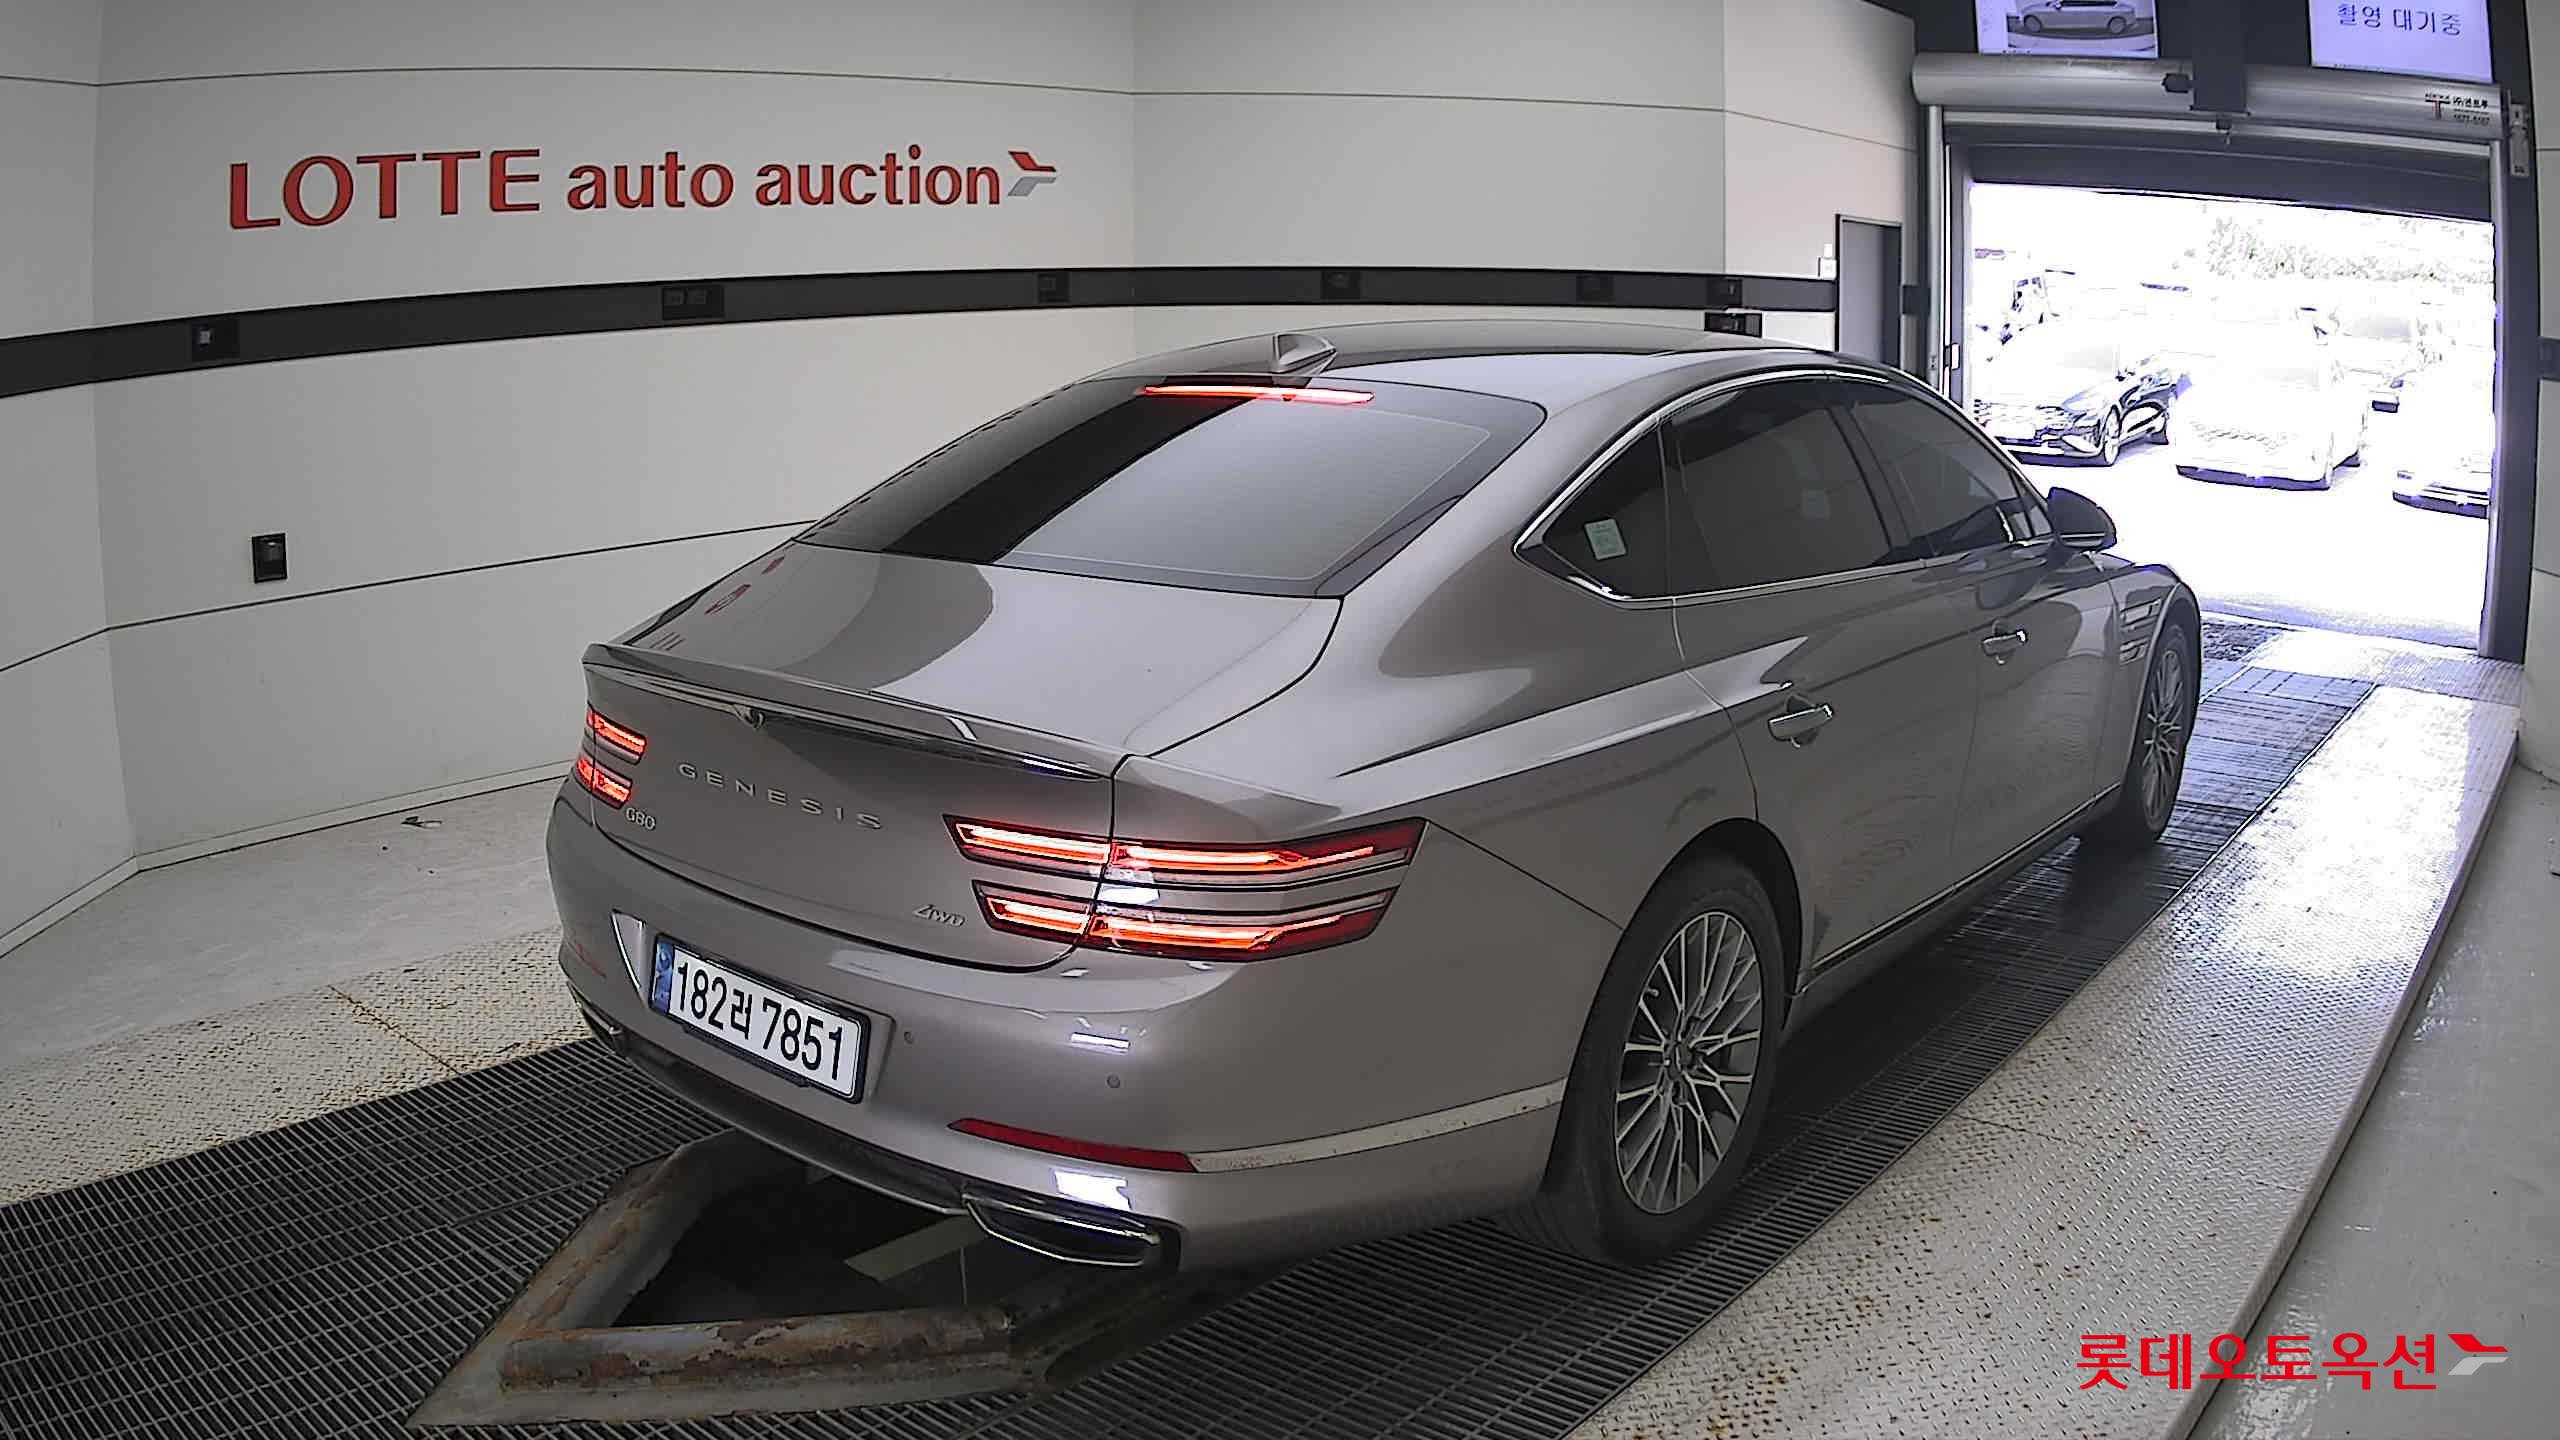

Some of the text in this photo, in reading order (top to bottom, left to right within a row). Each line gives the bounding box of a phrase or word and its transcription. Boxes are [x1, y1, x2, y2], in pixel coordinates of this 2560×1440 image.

[2337, 3, 2381, 29] 촬영
[229, 145, 1001, 230] LOTTE auto auction
[626, 807, 656, 830] G80
[679, 762, 882, 829] GENESIS
[677, 961, 843, 1081] 182러 7851
